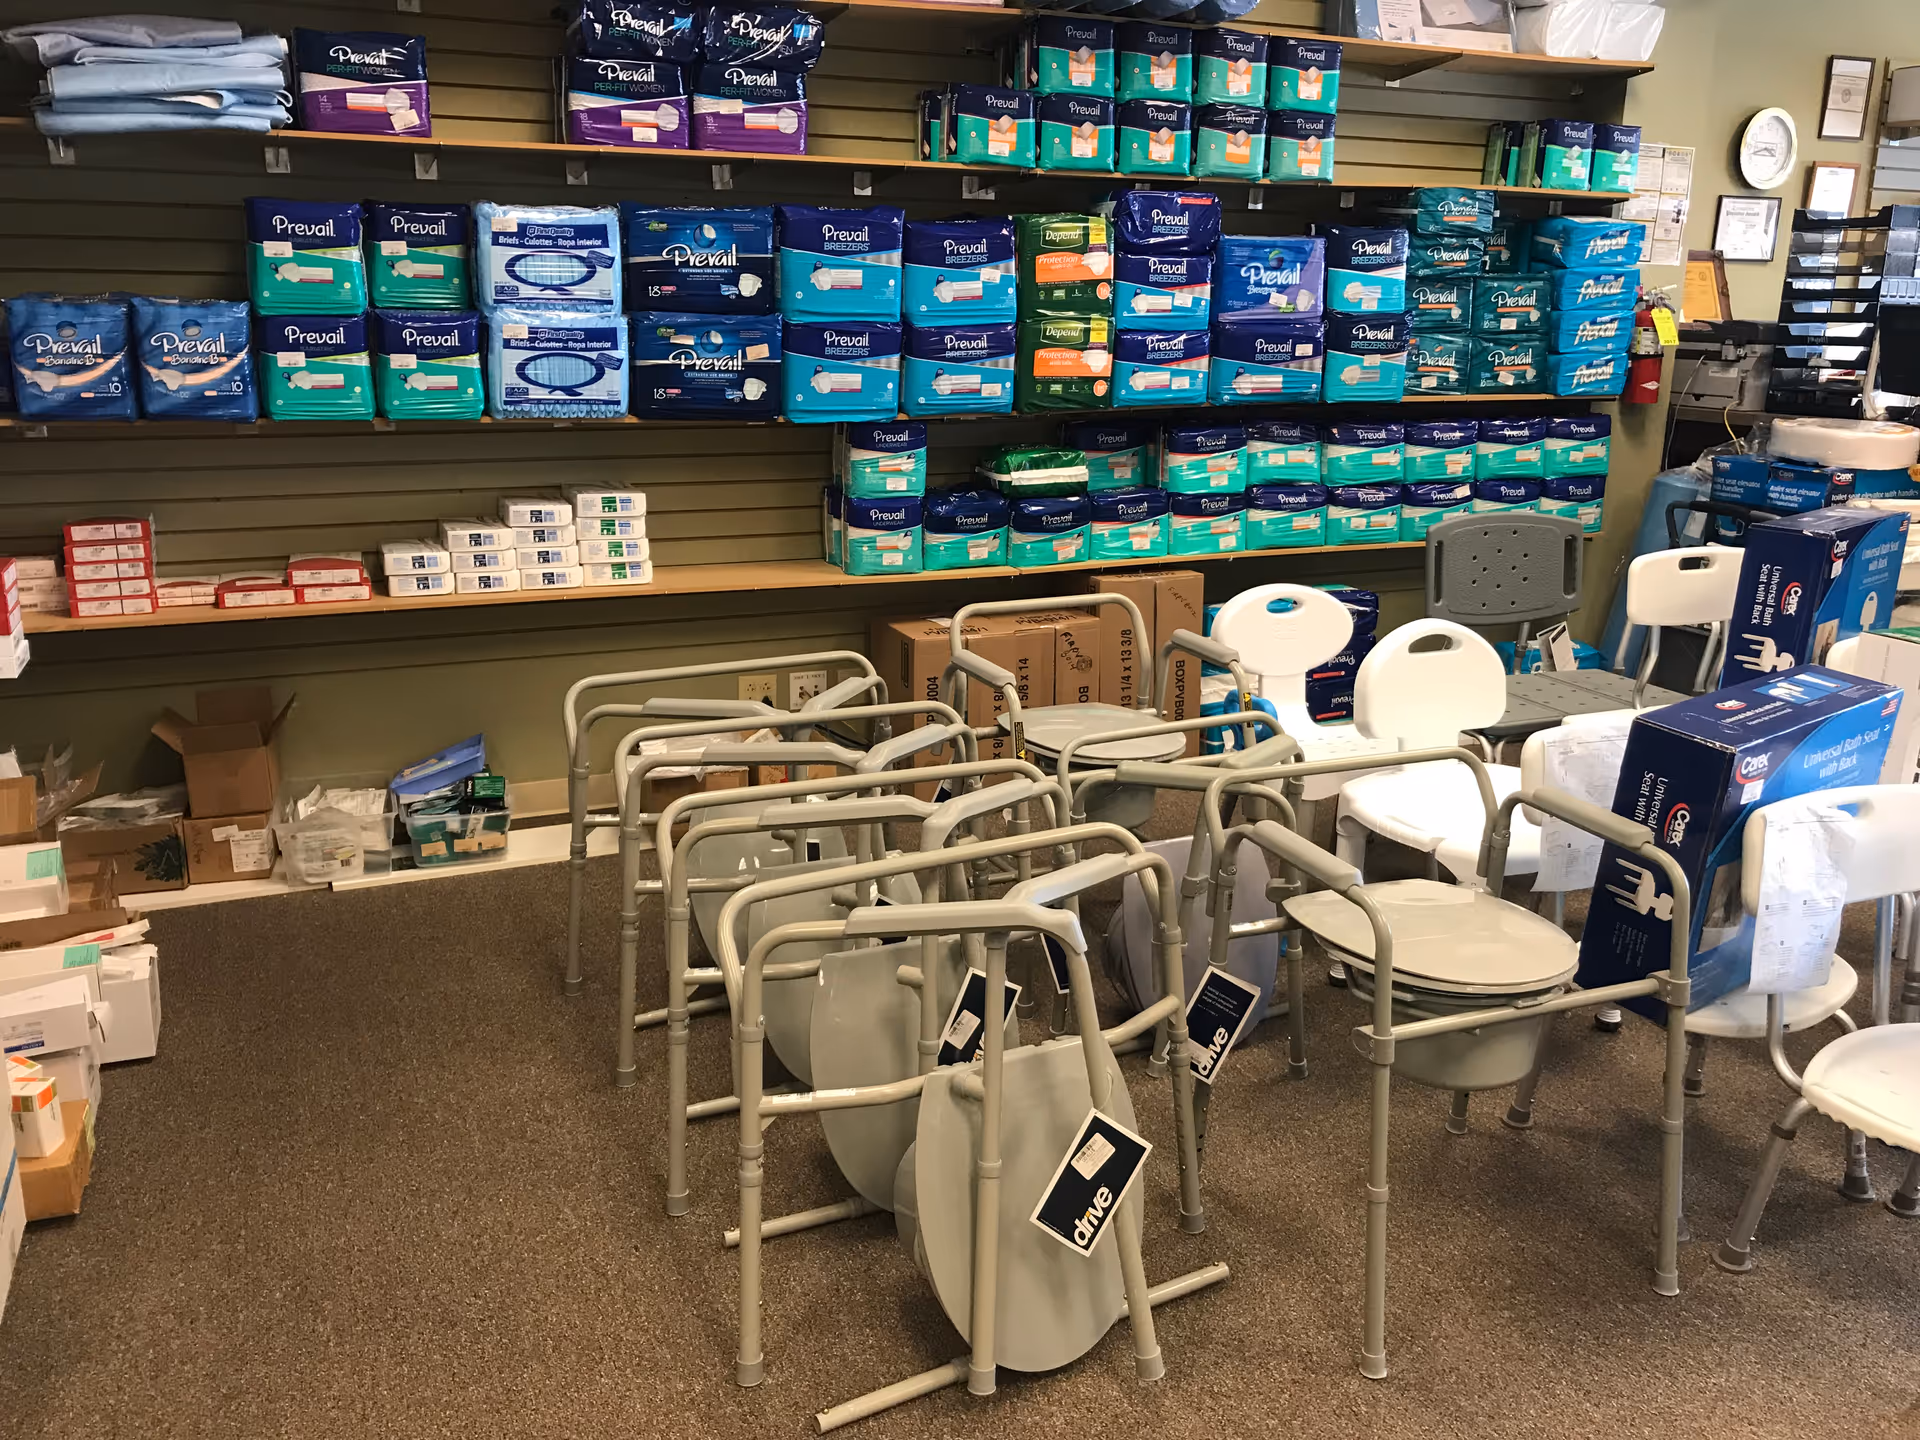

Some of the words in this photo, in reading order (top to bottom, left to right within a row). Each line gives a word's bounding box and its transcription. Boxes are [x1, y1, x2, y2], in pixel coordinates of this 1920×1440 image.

[611, 10, 665, 37] Prevail
[608, 26, 641, 41] PER-FIT
[641, 34, 675, 47] WOMEN
[1065, 25, 1097, 39] Prevail
[1147, 31, 1178, 45] Prevail
[1227, 38, 1254, 53] Prevail
[1297, 47, 1325, 61] Prevail
[326, 64, 360, 73] PER-FIT
[598, 62, 656, 82] Prevail
[724, 67, 778, 87] Prevail
[594, 82, 627, 92] PER-FIT
[628, 83, 665, 93] WOMEN
[720, 86, 750, 96] PER-FIT
[751, 87, 787, 98] WOMEN
[985, 94, 1019, 109] Prevail
[1069, 101, 1100, 116] Prevail
[1147, 107, 1178, 121] Prevail
[1297, 118, 1324, 130] Prevail
[1564, 126, 1588, 139] Prevail
[1613, 131, 1636, 143] Prevail
[1151, 209, 1189, 225] Prevail
[272, 215, 336, 237] Prevail
[390, 215, 447, 236] Prevail
[1152, 225, 1189, 235] BREEZERS
[822, 224, 869, 242] Prevail
[1045, 228, 1080, 243] Depend
[498, 235, 519, 244] Briefs
[524, 237, 552, 246] Culottes
[557, 238, 576, 248] Ropa
[576, 238, 602, 246] Interior
[823, 242, 870, 251] BREEZERS
[943, 238, 988, 255] Prevail
[1352, 238, 1393, 255] Prevail
[662, 243, 737, 267] Prevail
[945, 254, 988, 264] BREEZERS
[1038, 256, 1078, 264] Protection
[1427, 246, 1469, 261] Prevail
[1149, 259, 1187, 274] Prevail
[1240, 262, 1300, 285] Prevail
[1149, 274, 1188, 283] BREEZERS
[648, 285, 661, 297] 18
[1412, 286, 1457, 303] Prevail
[1490, 289, 1536, 307] Prevail
[285, 326, 346, 344] Prevail
[402, 328, 461, 346] Prevail
[824, 330, 869, 347] Prevail
[1046, 325, 1080, 339] Depend
[1352, 324, 1394, 340] Prevail
[23, 333, 102, 354] Prevail
[150, 332, 229, 354] Prevail
[510, 339, 530, 348] Briefs
[535, 340, 563, 348] Culottes
[568, 341, 586, 350] Ropa
[586, 340, 612, 348] Interior
[944, 334, 988, 350] Prevail
[1146, 337, 1184, 351] Prevail
[1255, 339, 1292, 353] Prevail
[824, 347, 870, 356] BREEZERS
[945, 349, 988, 358] BREEZERS
[1038, 350, 1078, 359] Protection
[1146, 350, 1185, 359] BREEZERS
[1255, 353, 1291, 361] BREEZERS
[1412, 350, 1457, 367] Prevail
[1488, 348, 1533, 366] Prevail
[668, 348, 743, 371] Prevail
[108, 382, 121, 393] 10
[231, 381, 243, 393] 10
[653, 388, 666, 399] 18
[873, 430, 909, 442] Prevail
[1272, 425, 1300, 437] Prevail
[1356, 429, 1387, 440] Prevail
[1433, 430, 1461, 441] Prevail
[1570, 424, 1595, 434] Prevail
[1097, 431, 1127, 445] Prevail
[1196, 434, 1227, 447] Prevail
[1835, 472, 1854, 480] Carex
[1500, 485, 1525, 496] Prevail
[1568, 485, 1592, 496] Prevail
[1722, 485, 1744, 494] handles
[1737, 479, 1761, 488] elevator
[1357, 491, 1385, 502] Prevail
[1769, 485, 1785, 493] toilet
[1797, 488, 1821, 497] elevator
[1780, 492, 1803, 502] handles
[1831, 493, 1847, 501] toilet
[1884, 490, 1897, 498] with
[1200, 496, 1229, 510] Prevail
[1278, 493, 1308, 504] Prevail
[870, 508, 905, 521] Prevail
[1117, 501, 1148, 515] Prevail
[955, 513, 988, 526] Prevail
[1041, 512, 1073, 525] Prevail
[1833, 539, 1849, 553] Carex
[1759, 563, 1771, 583] Seat
[1766, 566, 1783, 606] Universal
[1755, 584, 1766, 603] with
[1786, 587, 1803, 617] Carex
[1750, 604, 1763, 625] Back
[1762, 607, 1774, 627] Bath
[1121, 628, 1132, 647] 3/8
[1121, 648, 1132, 663] 13
[1018, 657, 1029, 671] 14
[1121, 674, 1132, 692] 1/4
[1121, 695, 1132, 707] 13
[1803, 743, 1842, 769] Universal
[1843, 733, 1863, 754] Bath
[1863, 727, 1881, 746] Seat
[1741, 751, 1772, 775] Carex
[1818, 758, 1838, 779] with
[1838, 752, 1857, 772] Back
[1640, 770, 1655, 796] Seat
[1633, 796, 1647, 822] with
[1647, 776, 1668, 829] Universal
[1669, 809, 1691, 848] Carex
[1197, 1027, 1229, 1077] drive
[1073, 1186, 1113, 1247] drive
